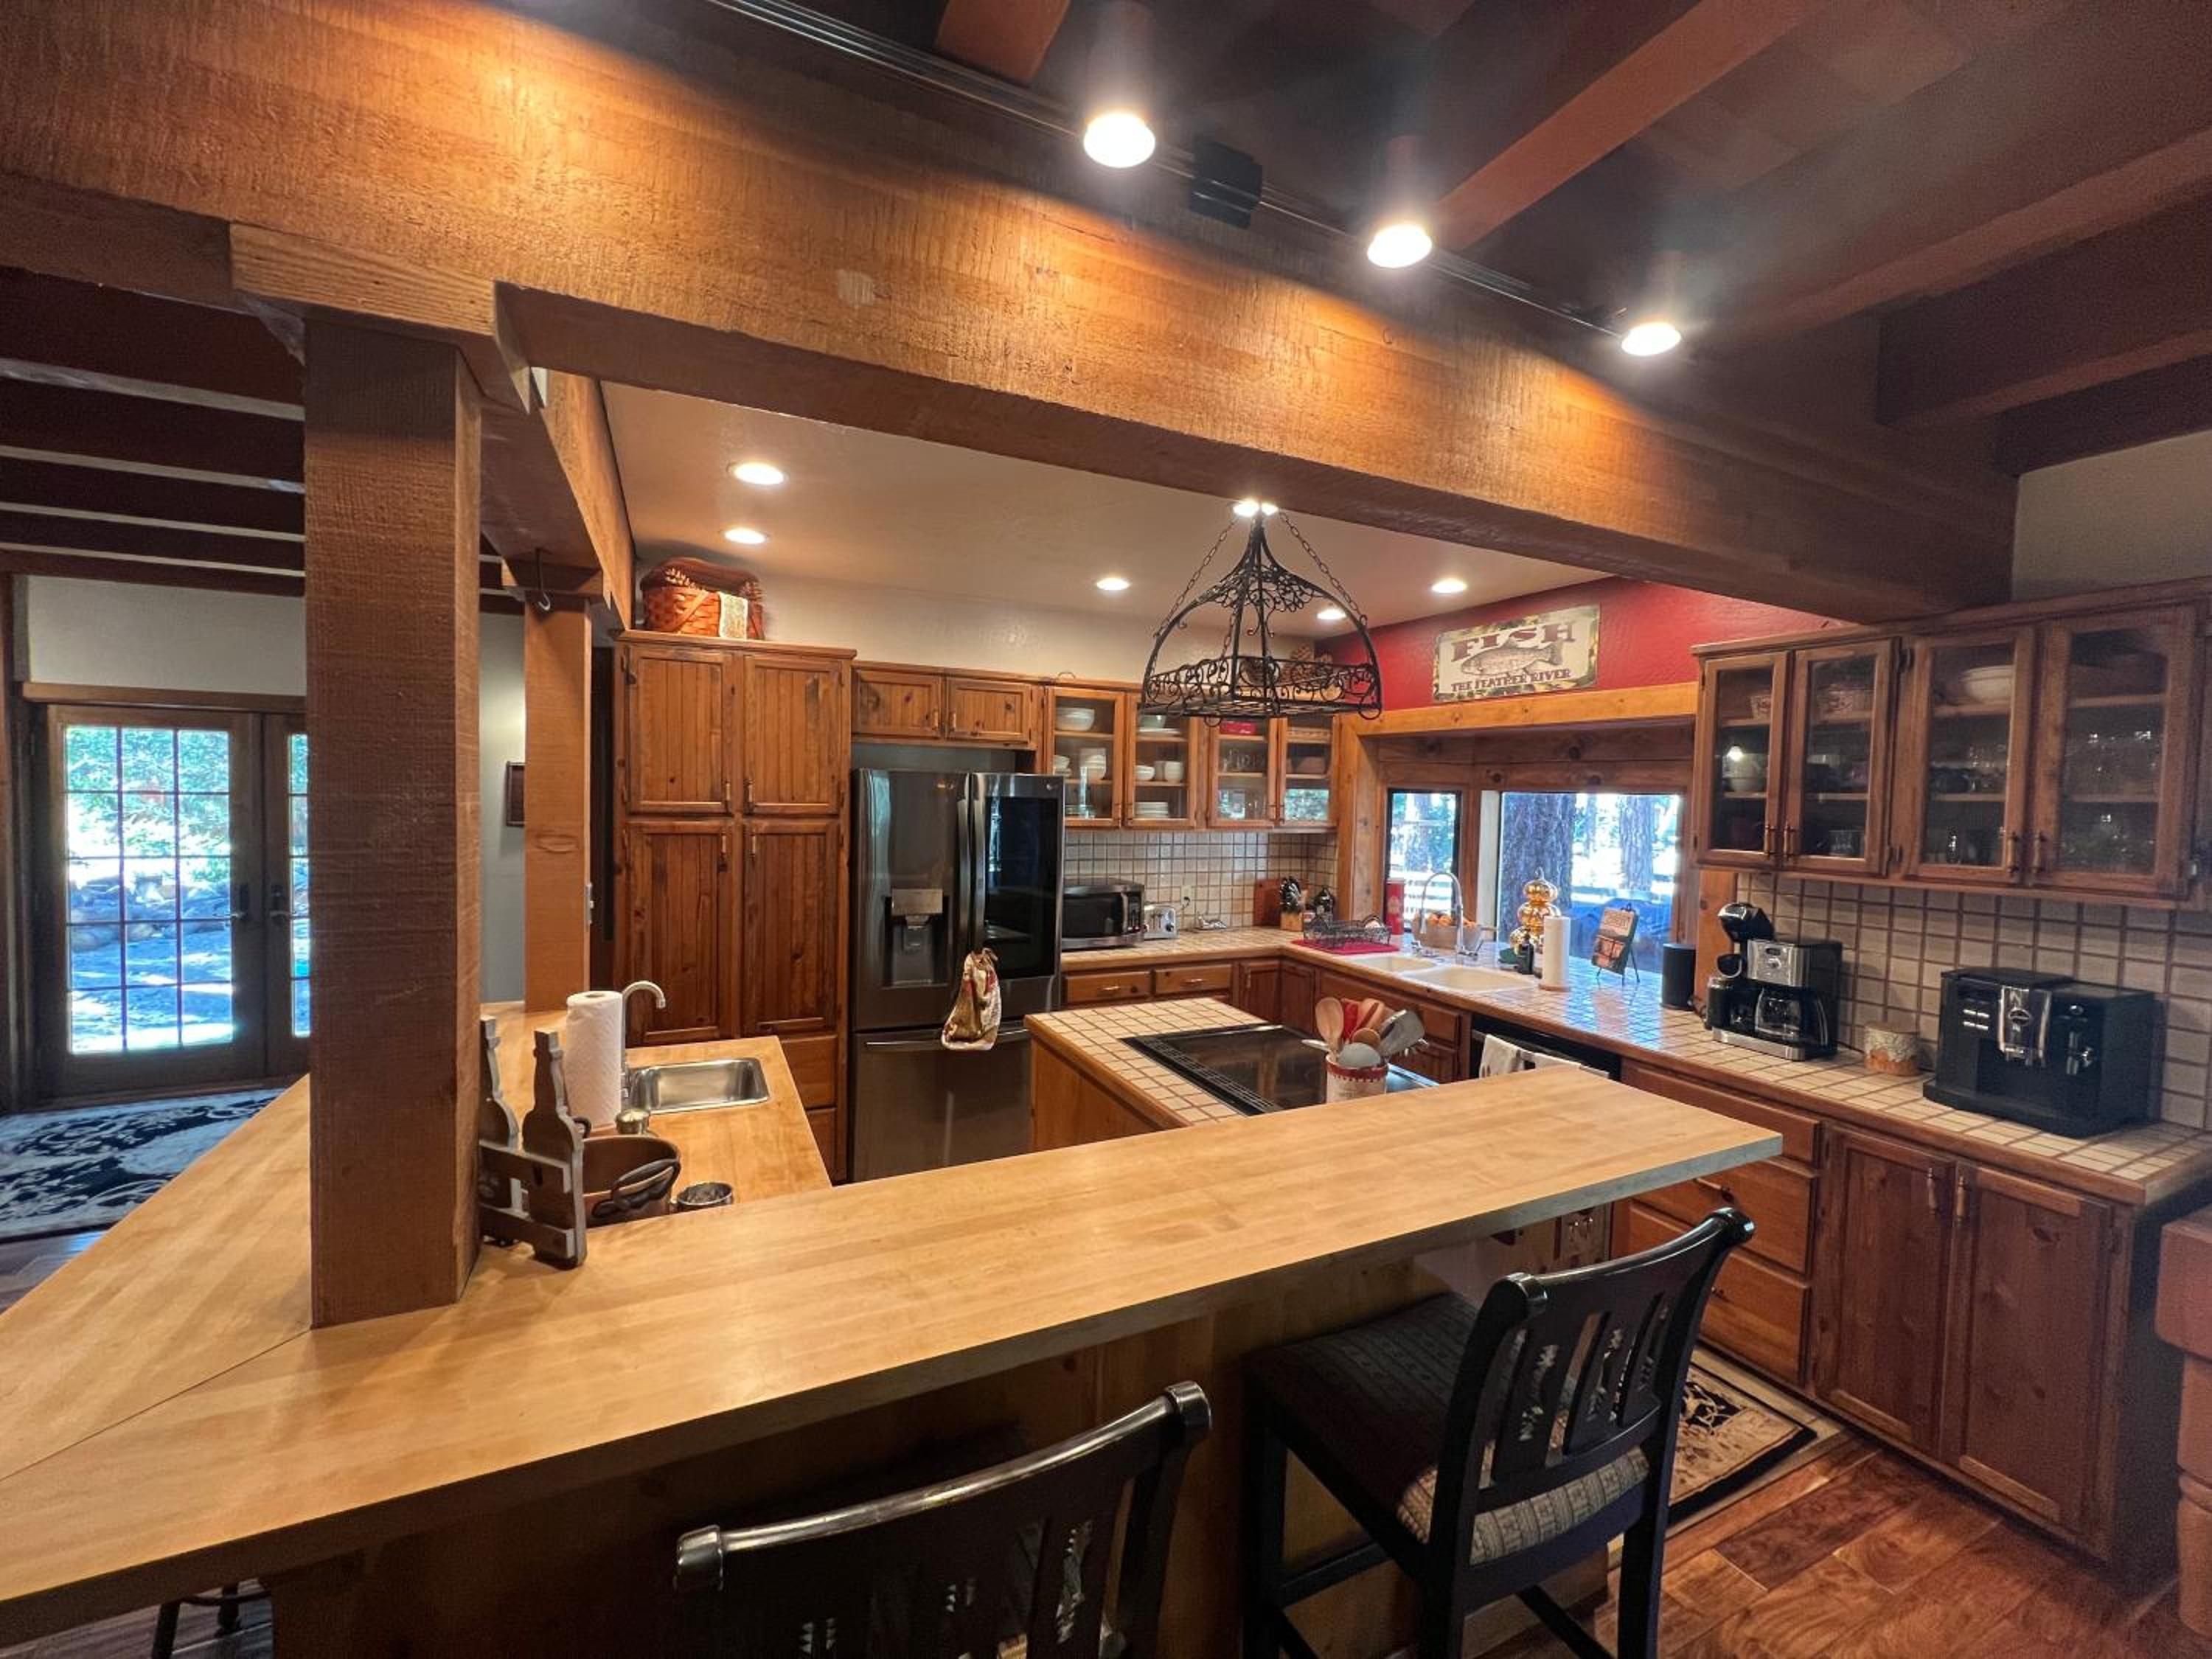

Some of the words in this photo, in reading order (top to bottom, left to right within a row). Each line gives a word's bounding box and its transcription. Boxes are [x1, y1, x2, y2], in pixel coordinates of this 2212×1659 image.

[1450, 621, 1576, 662] FISH
[1450, 681, 1472, 692] THE
[1475, 672, 1528, 689] FEATHER
[1530, 668, 1571, 682] RIVER
